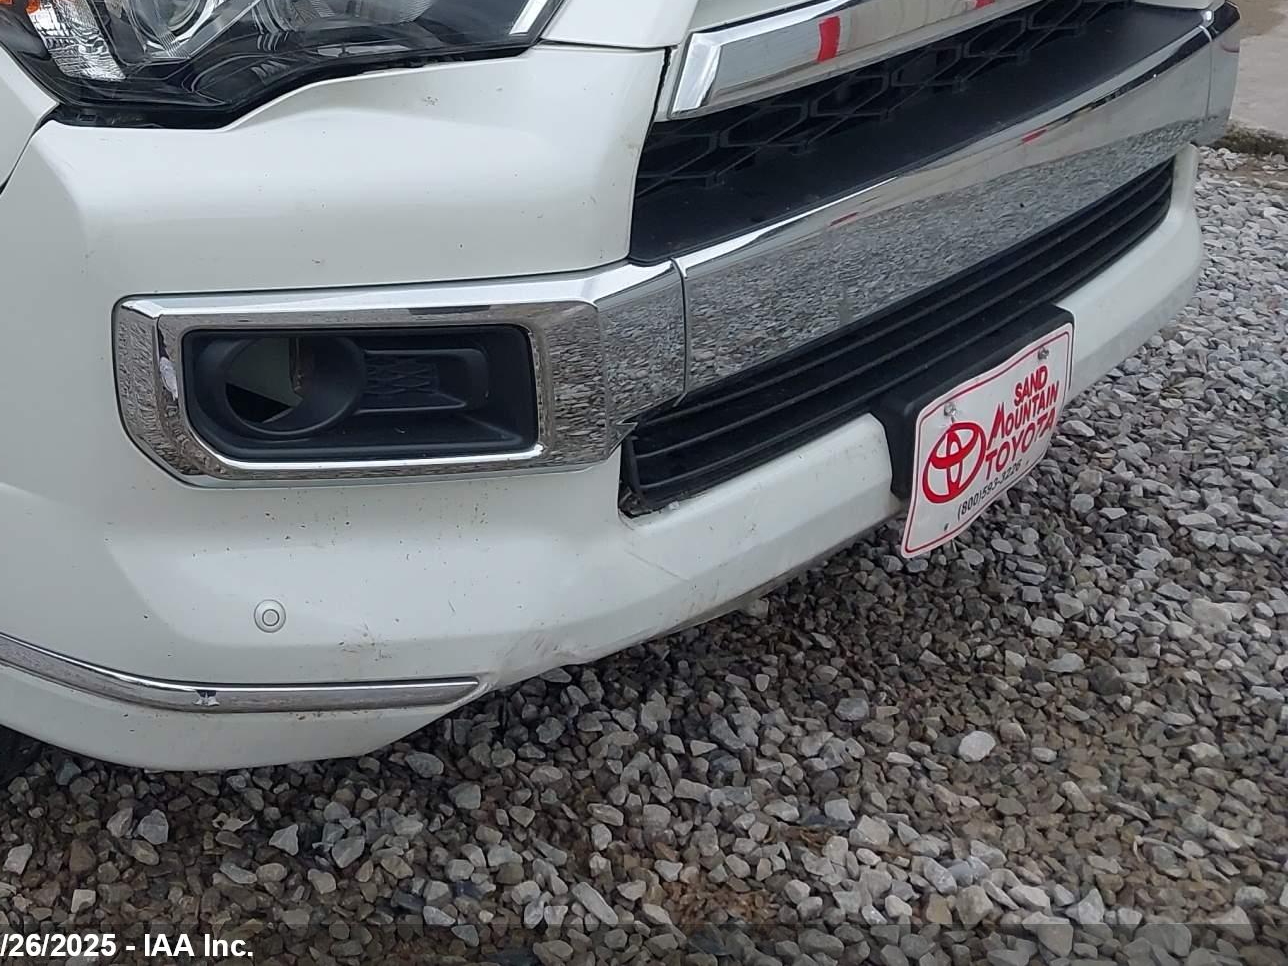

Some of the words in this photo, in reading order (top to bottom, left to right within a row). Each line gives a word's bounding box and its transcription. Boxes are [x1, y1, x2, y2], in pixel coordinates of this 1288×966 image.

[987, 381, 1060, 451] MOUNTAIN
[1014, 365, 1048, 405] SAND
[985, 407, 1057, 480] TOYOTA
